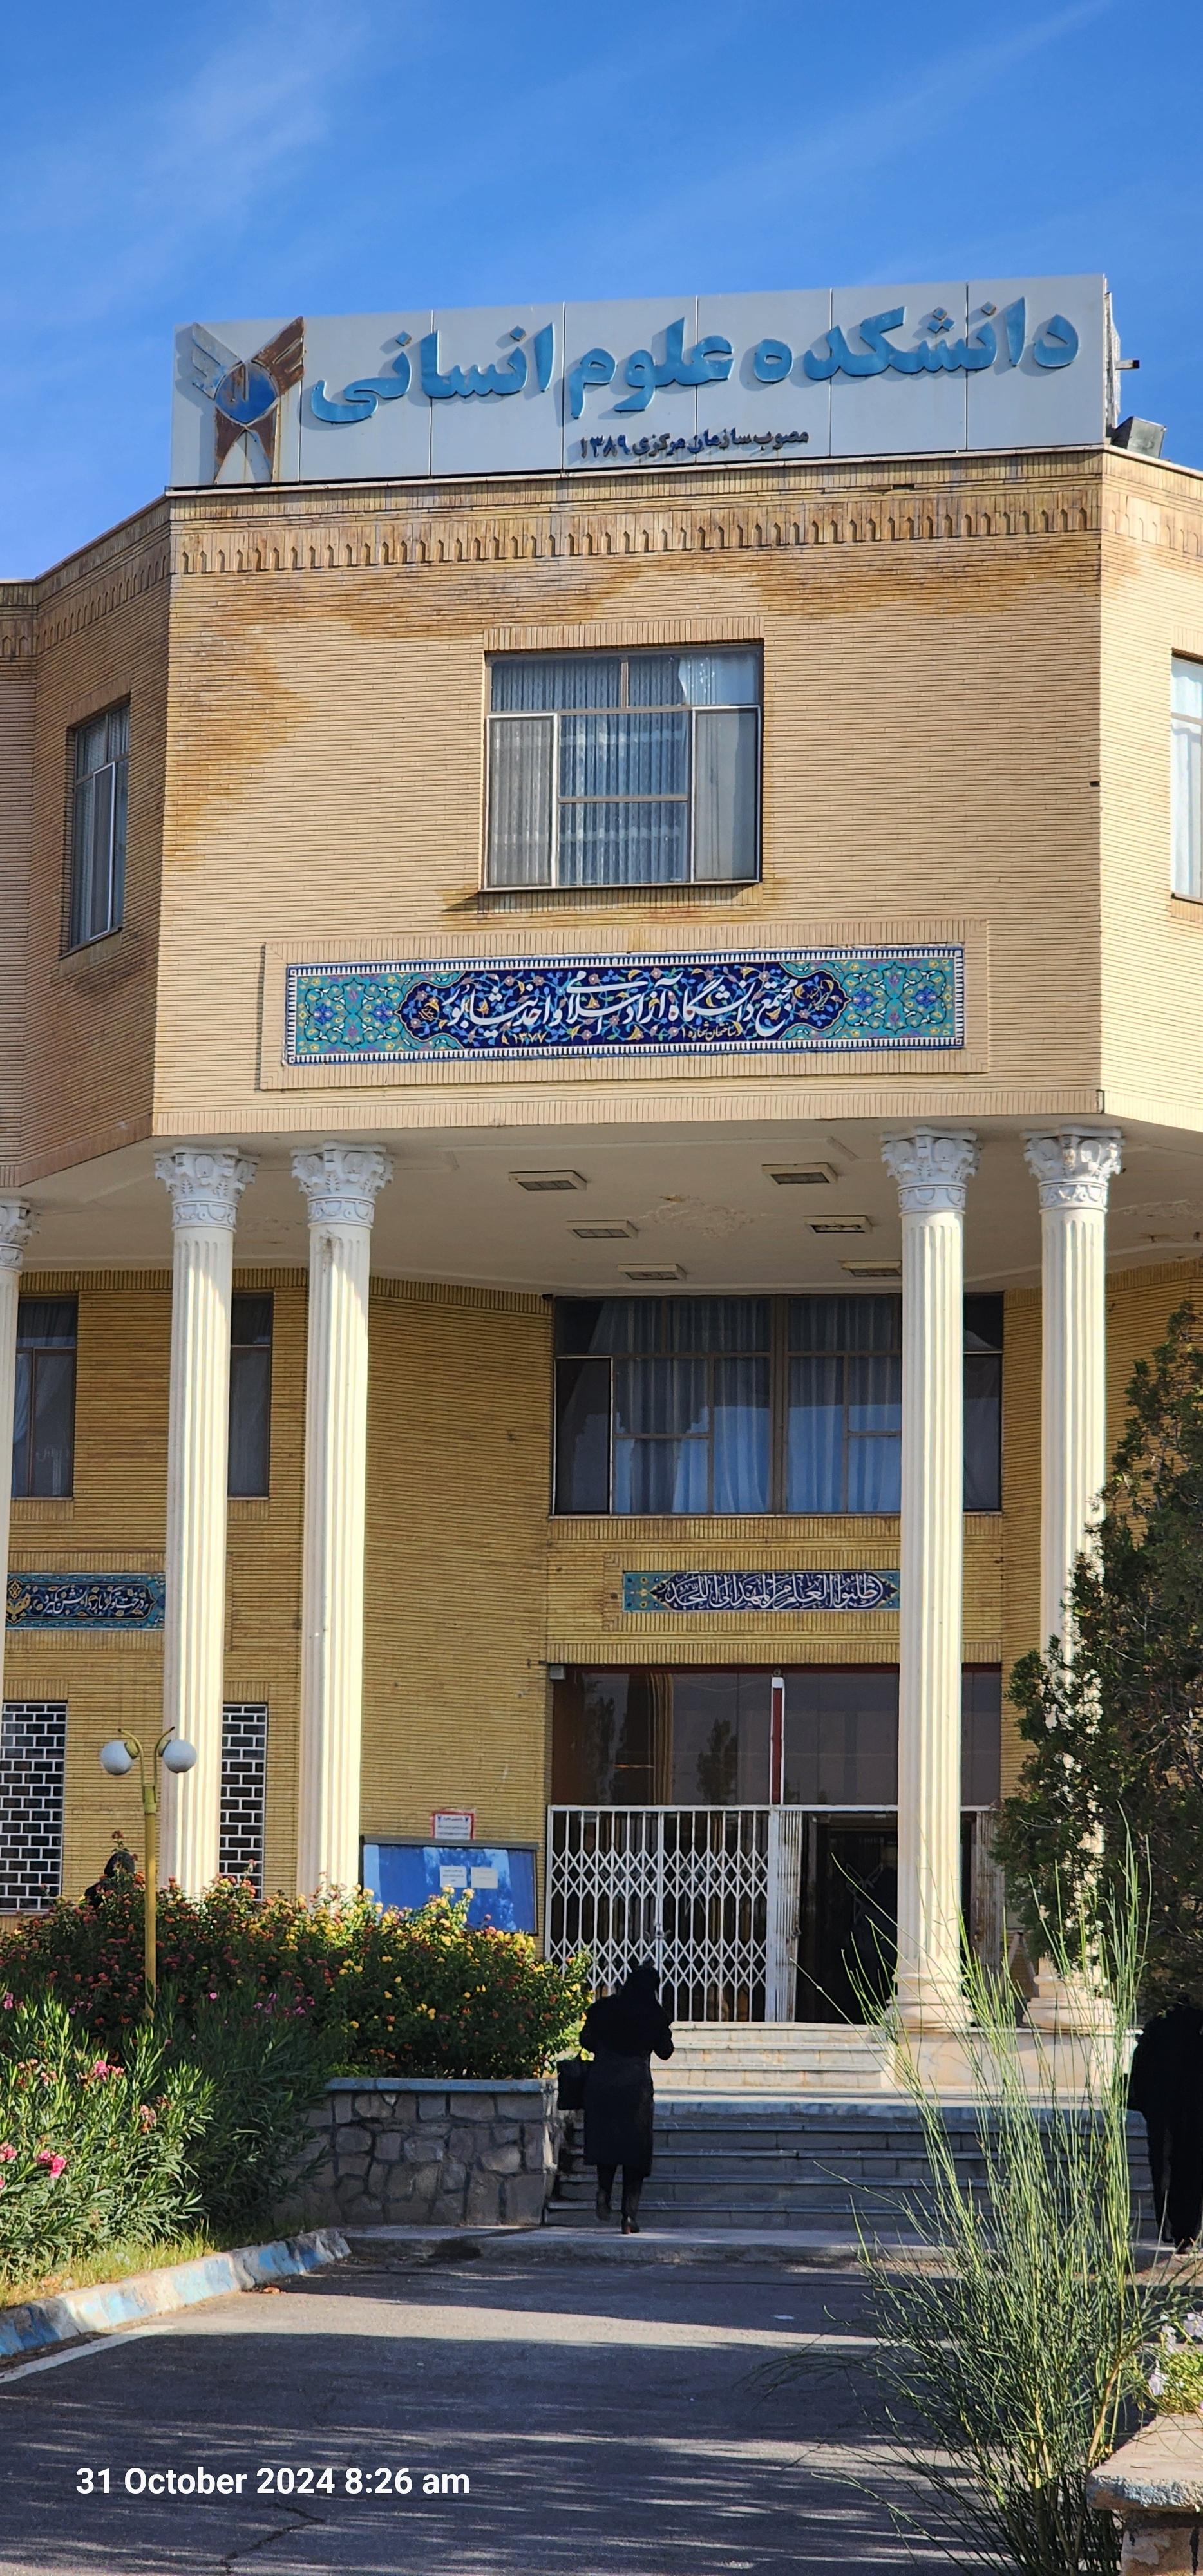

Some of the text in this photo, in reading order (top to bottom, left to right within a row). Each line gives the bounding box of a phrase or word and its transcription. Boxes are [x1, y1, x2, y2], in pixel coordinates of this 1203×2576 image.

[311, 296, 1079, 424] دانشکده علوم انسانی
[581, 427, 809, 458] مصوب سازمان مرکزی ۱۳۸۹
[442, 984, 539, 1037] نیشابور
[512, 995, 563, 1027] واحد
[566, 971, 649, 1035] اسلامی
[622, 972, 684, 1023] آزاد
[668, 975, 756, 1022] دانشگاه
[755, 979, 799, 1037] مجتمع
[513, 1032, 547, 1043] ۱۳۷۷
